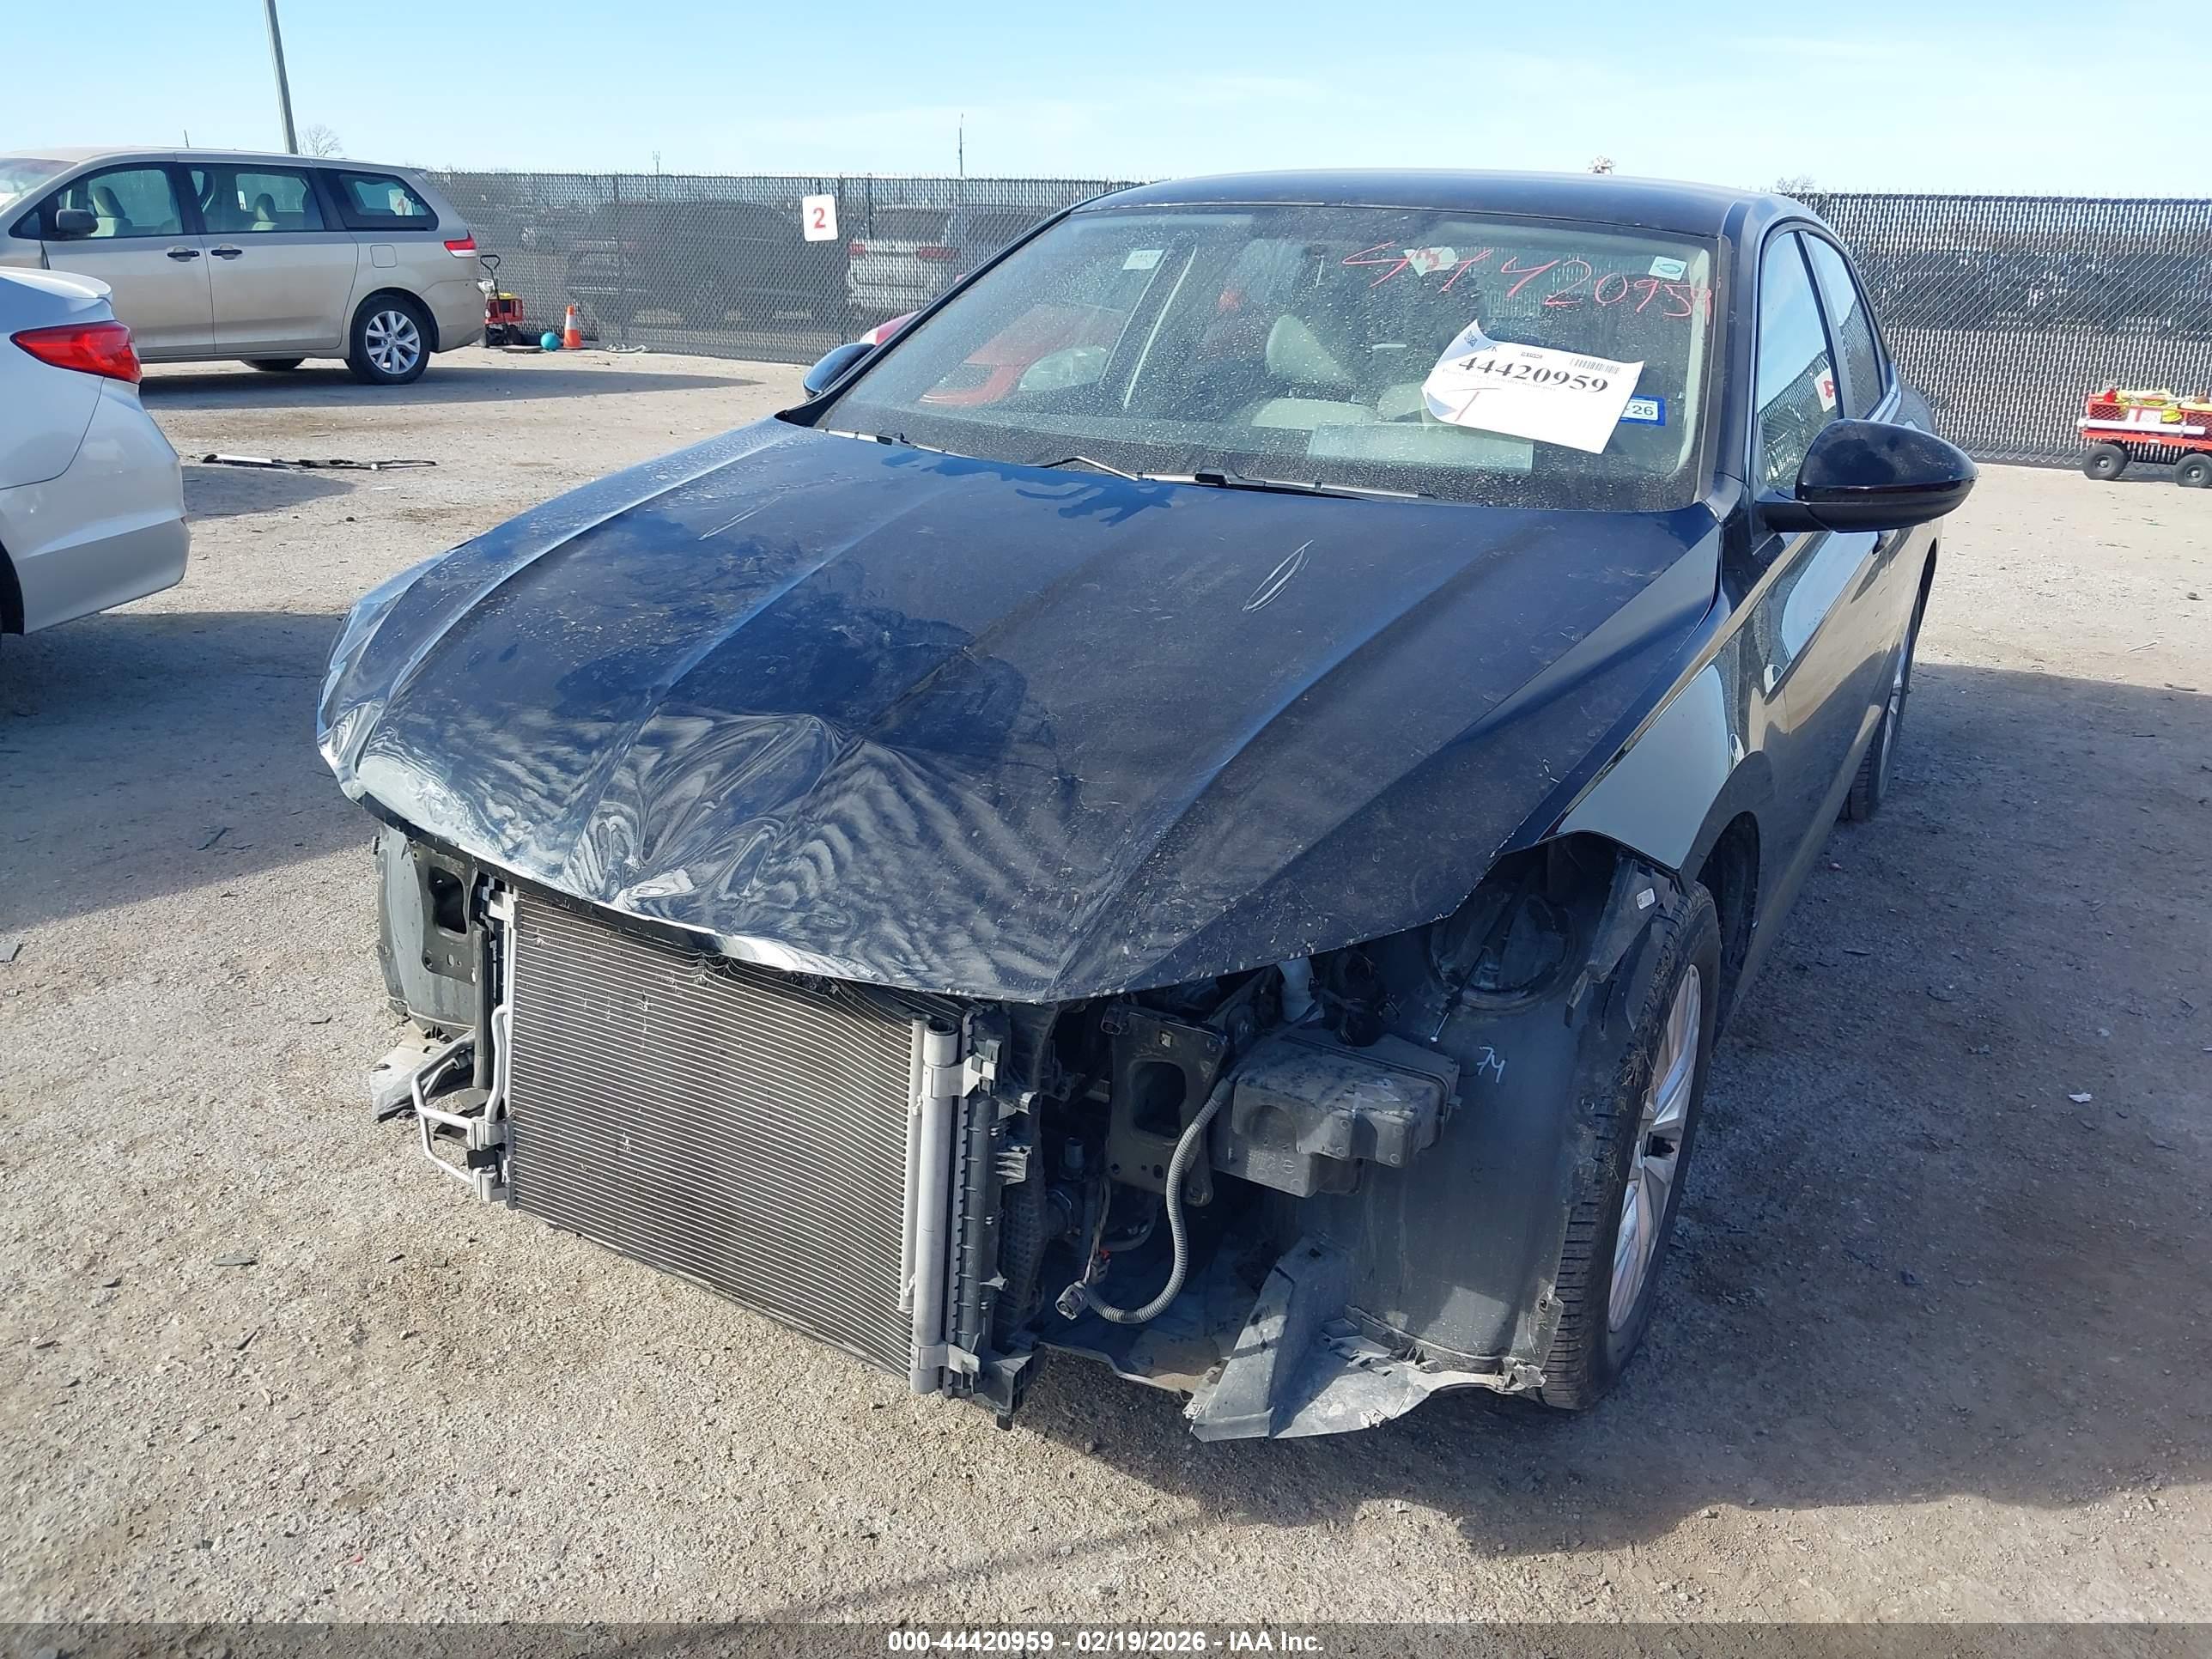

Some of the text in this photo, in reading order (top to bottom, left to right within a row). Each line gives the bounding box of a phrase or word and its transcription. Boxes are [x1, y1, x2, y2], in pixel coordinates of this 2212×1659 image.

[813, 207, 826, 229] 2
[1458, 356, 1609, 393] 44420959
[1632, 404, 1654, 416] 26
[1475, 1046, 1505, 1084] 74
